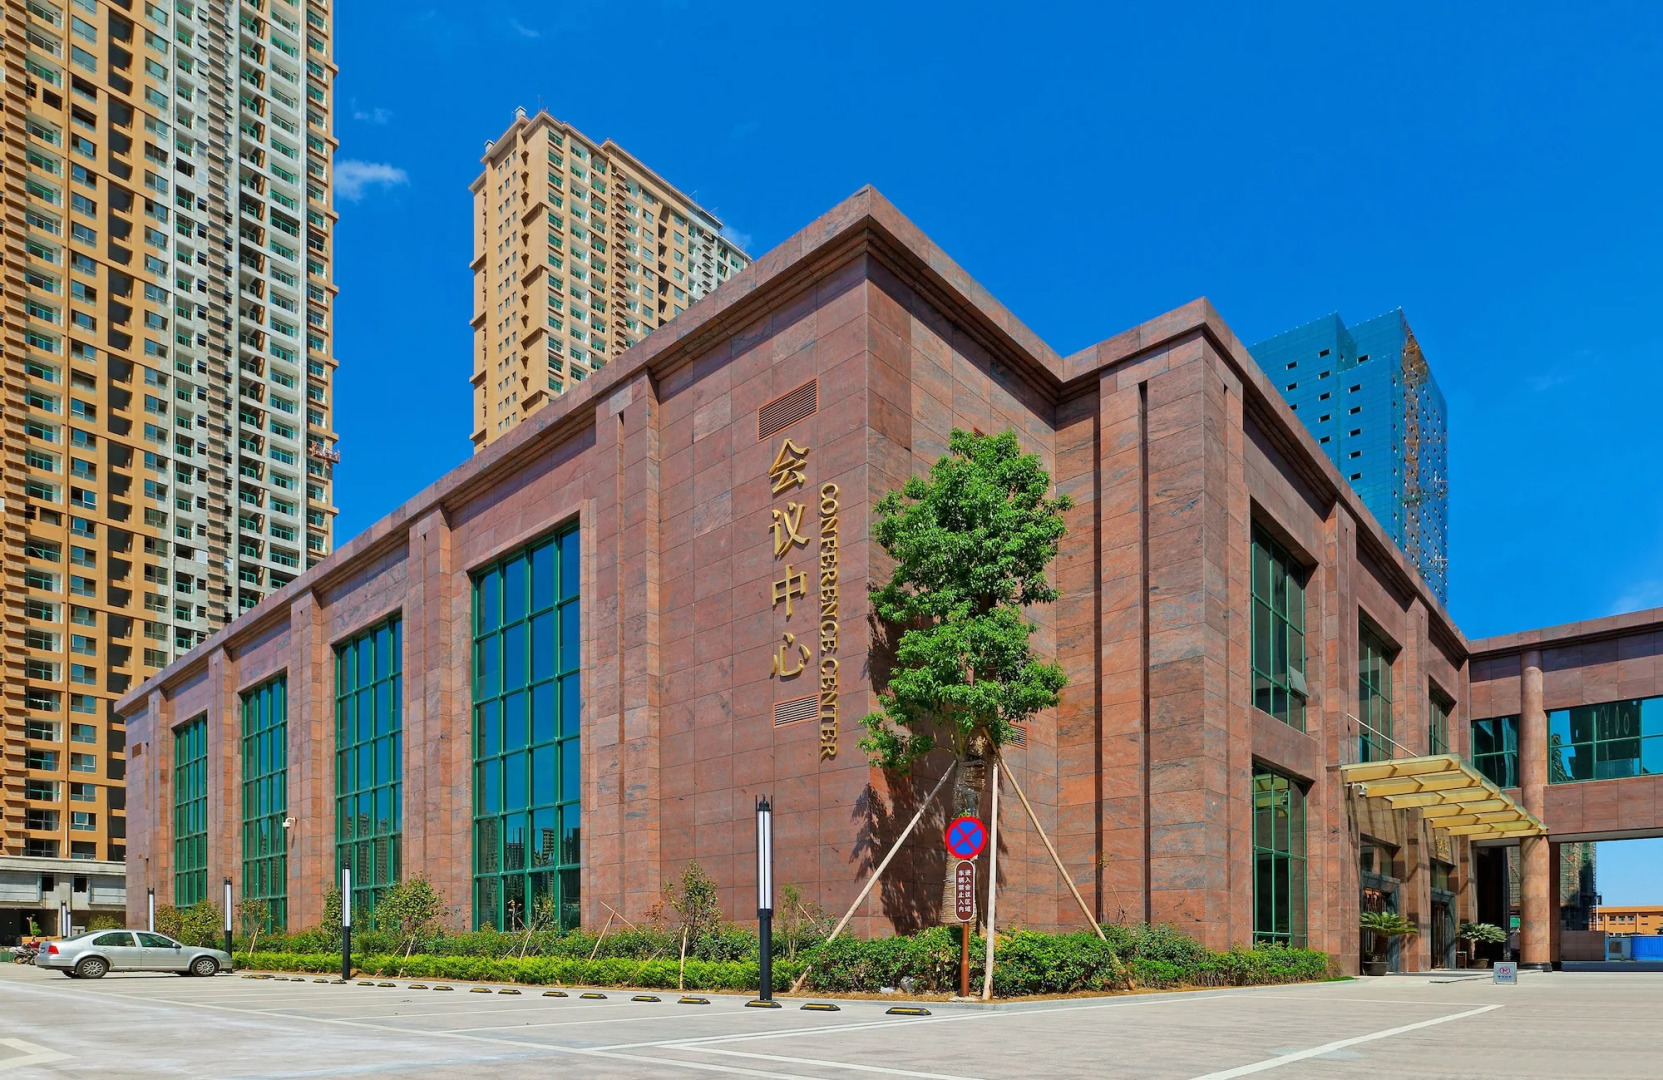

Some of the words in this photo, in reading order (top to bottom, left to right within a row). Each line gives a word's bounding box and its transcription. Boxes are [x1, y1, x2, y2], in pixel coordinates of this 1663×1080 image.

[768, 438, 810, 677] 会议中心
[820, 482, 839, 652] CONFERENCE
[820, 657, 839, 763] CENTER
